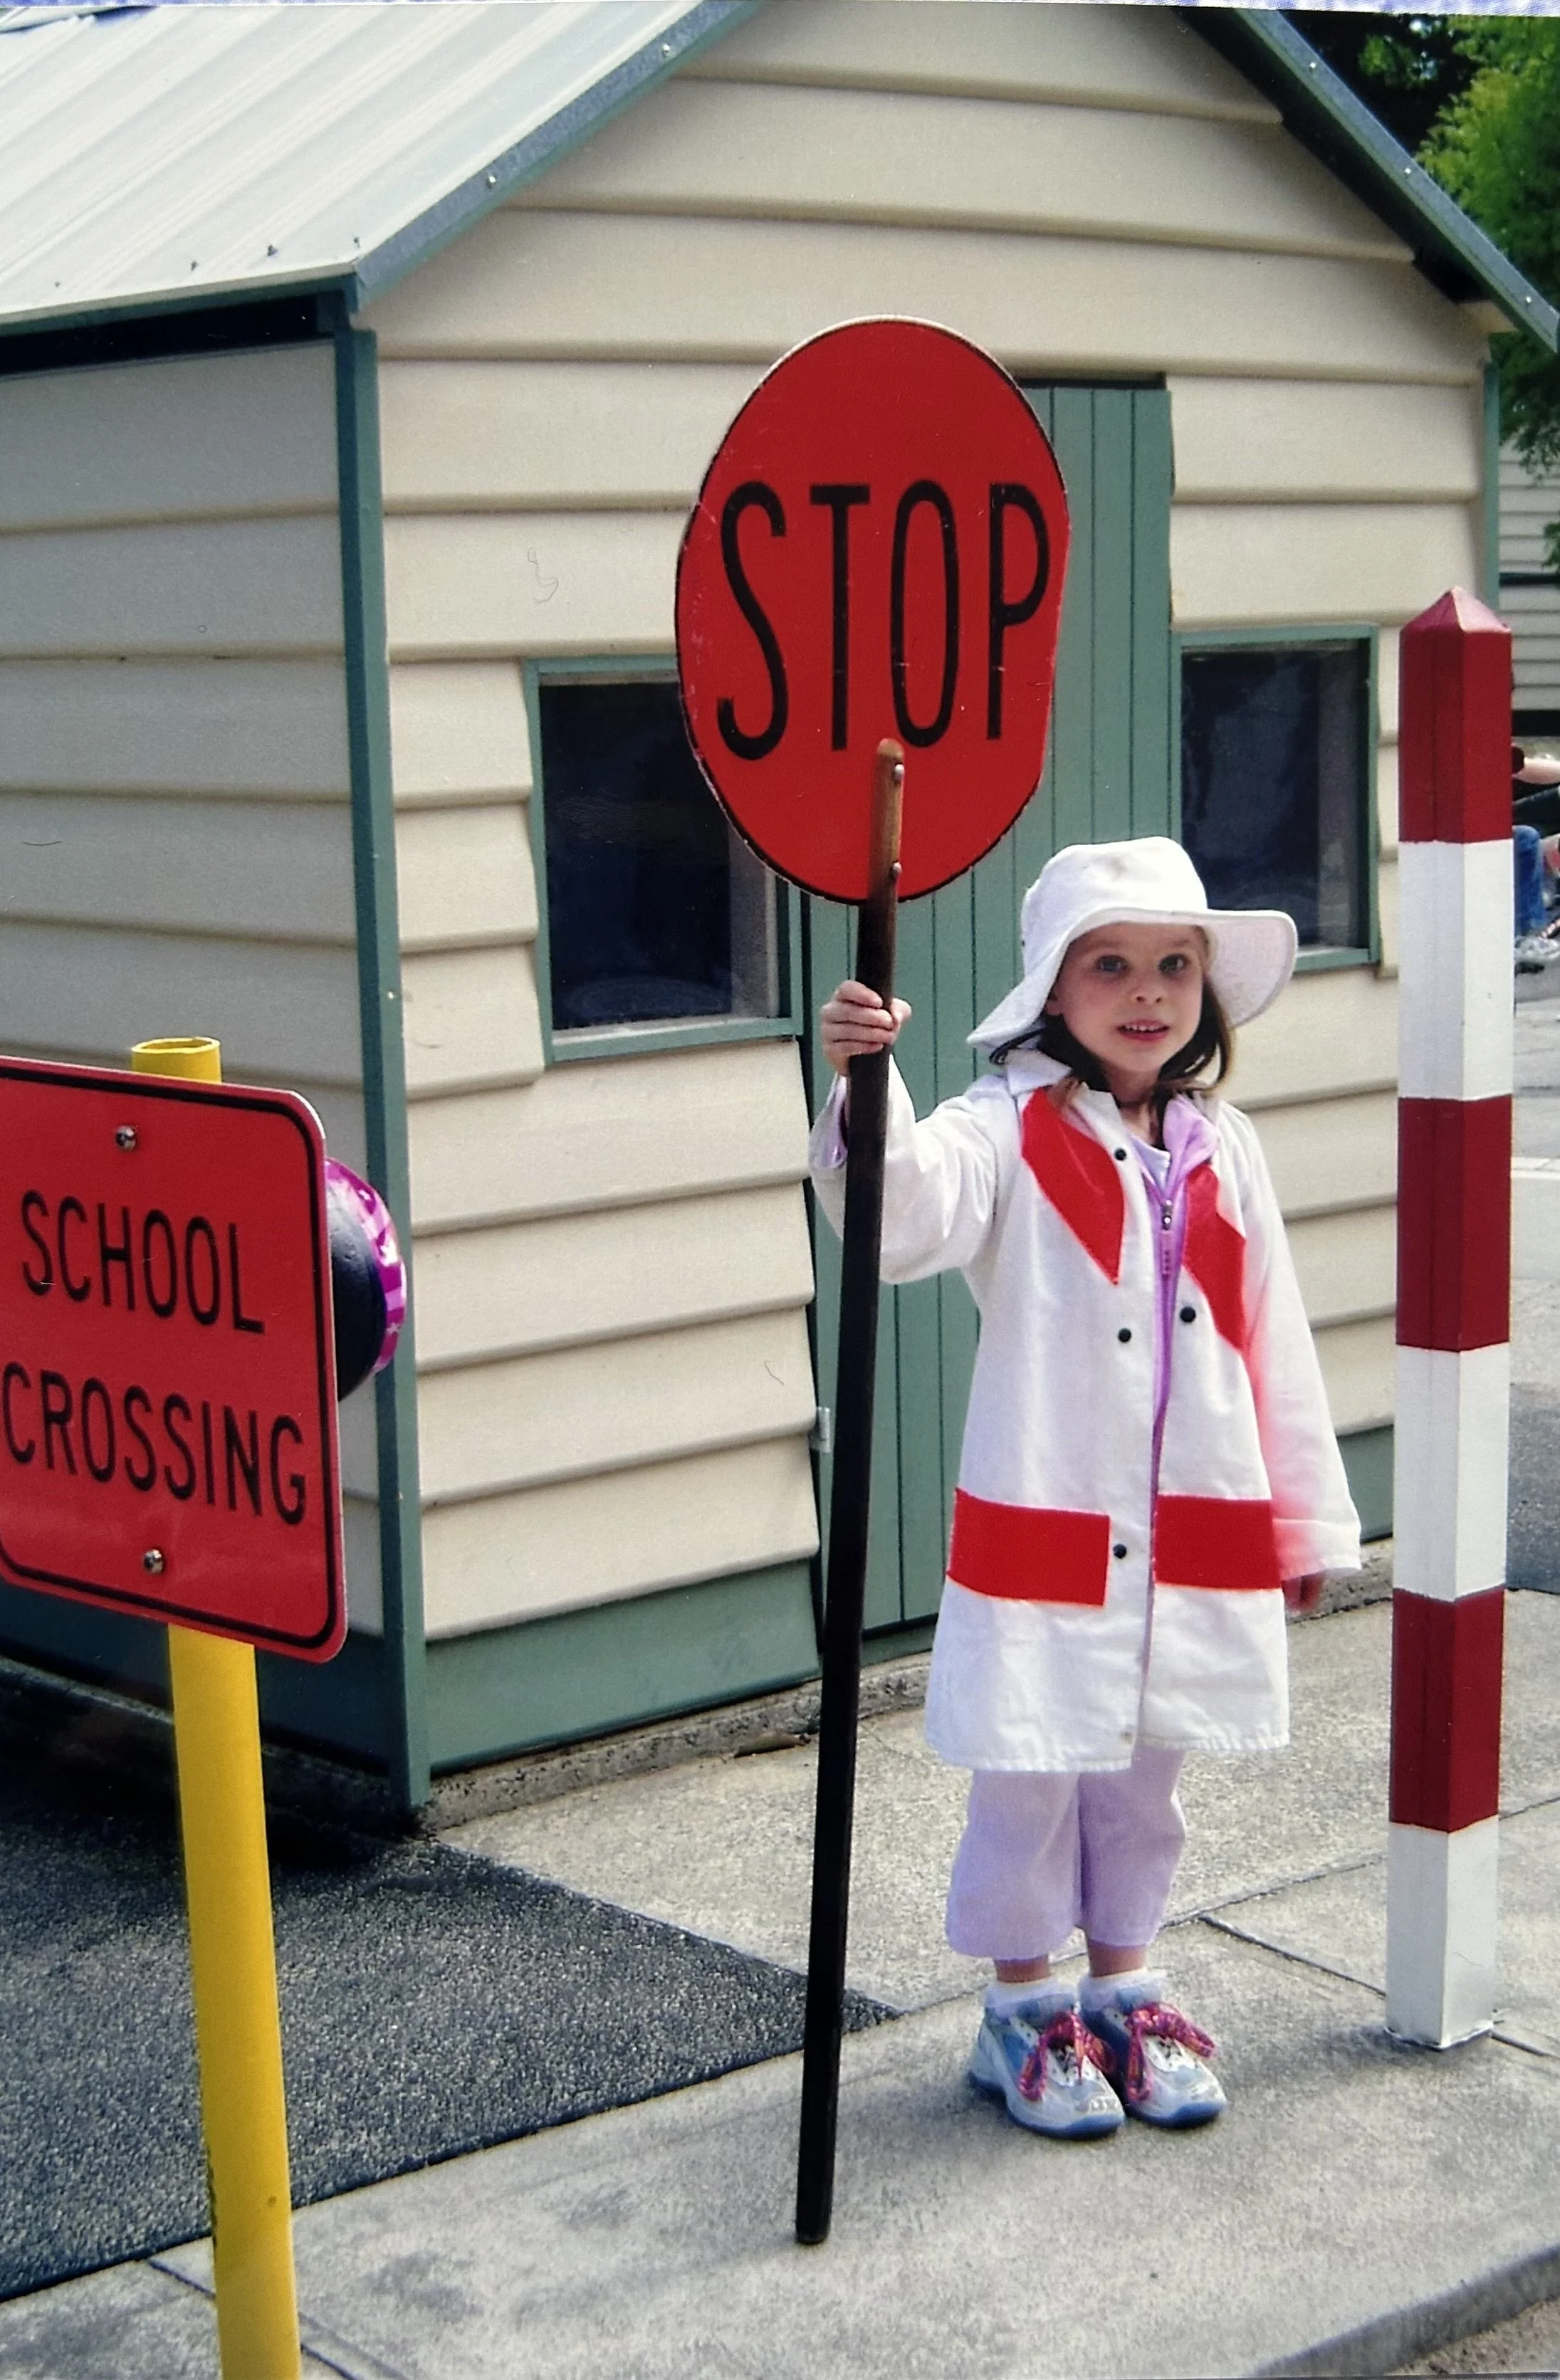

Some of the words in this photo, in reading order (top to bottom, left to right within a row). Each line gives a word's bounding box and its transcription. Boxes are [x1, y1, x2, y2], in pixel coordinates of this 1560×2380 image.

[718, 479, 1051, 761] STOP
[21, 1190, 264, 1333] SCHOOL
[2, 1362, 306, 1525] CROSSING
